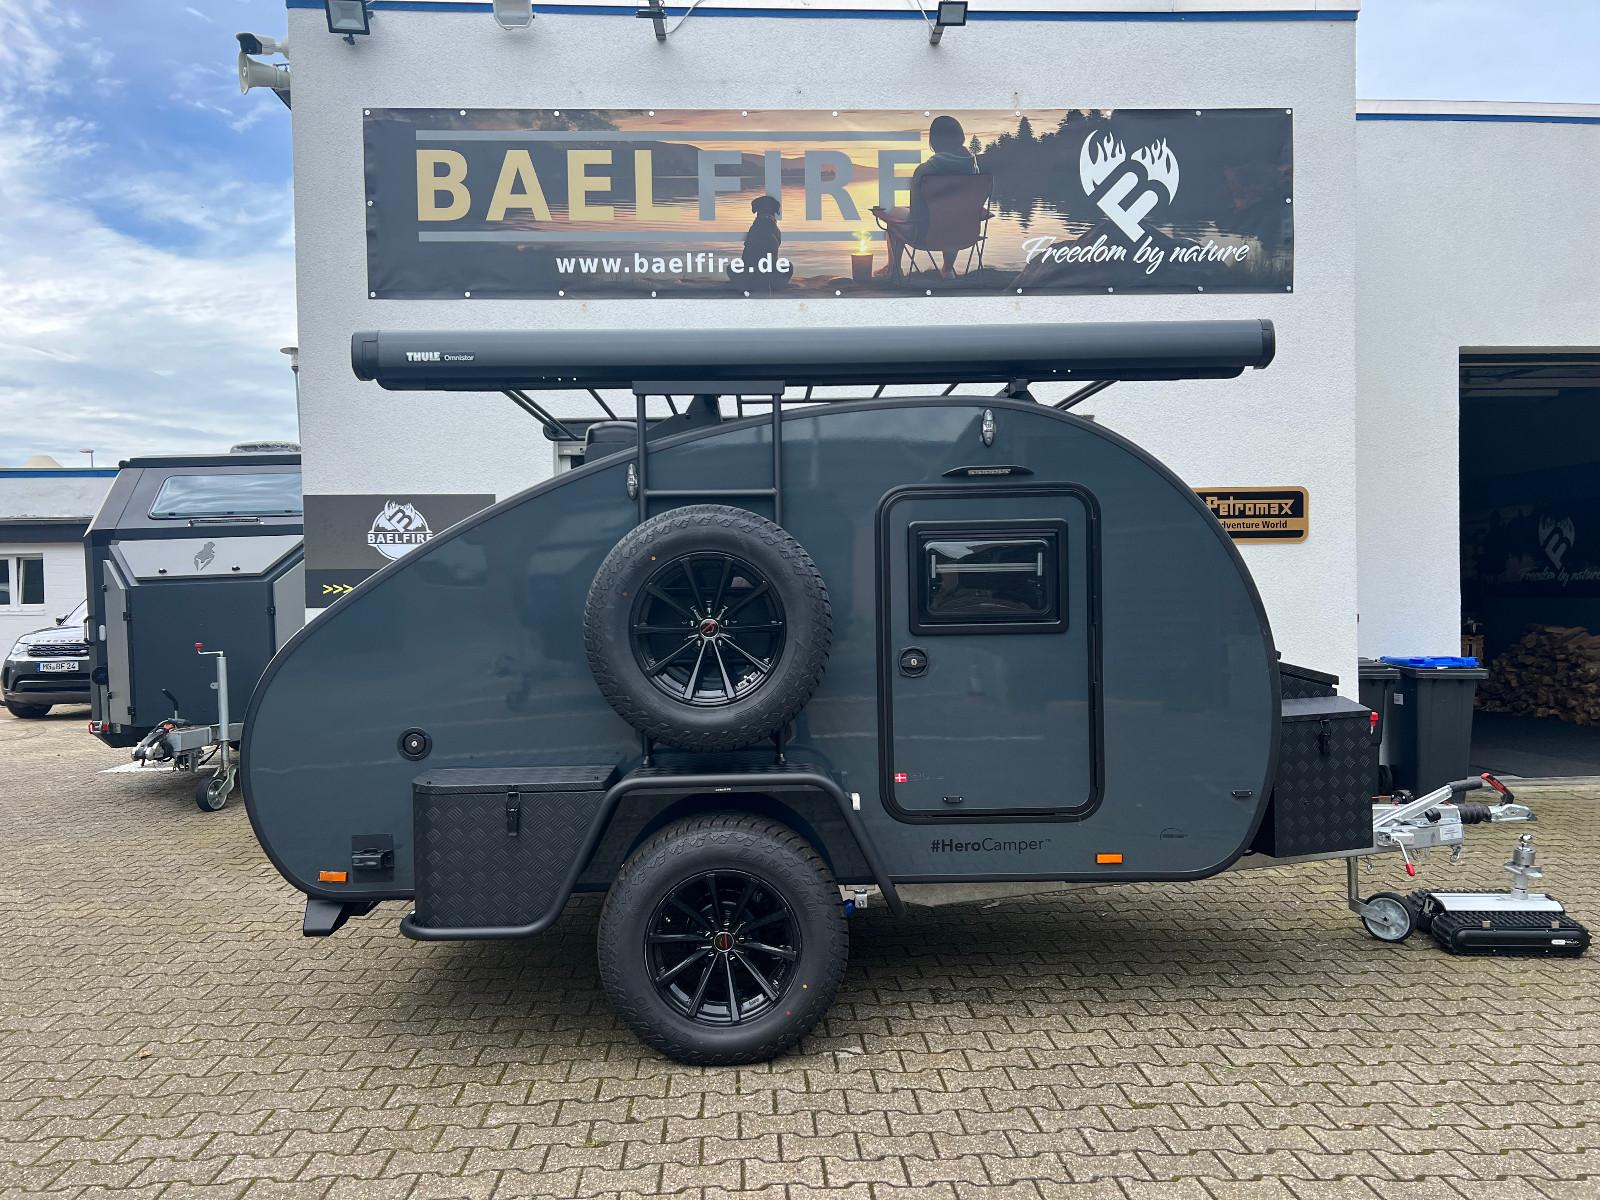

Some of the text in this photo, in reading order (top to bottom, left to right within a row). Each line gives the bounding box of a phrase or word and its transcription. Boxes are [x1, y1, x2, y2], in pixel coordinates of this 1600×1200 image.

[415, 149, 922, 222] BAELFIRE
[556, 253, 791, 274] www.baelfire.de
[1022, 234, 1250, 274] Freedom by nature
[406, 351, 475, 362] THULE Omnistor
[1205, 496, 1295, 516] Petromax
[1262, 520, 1288, 529] World
